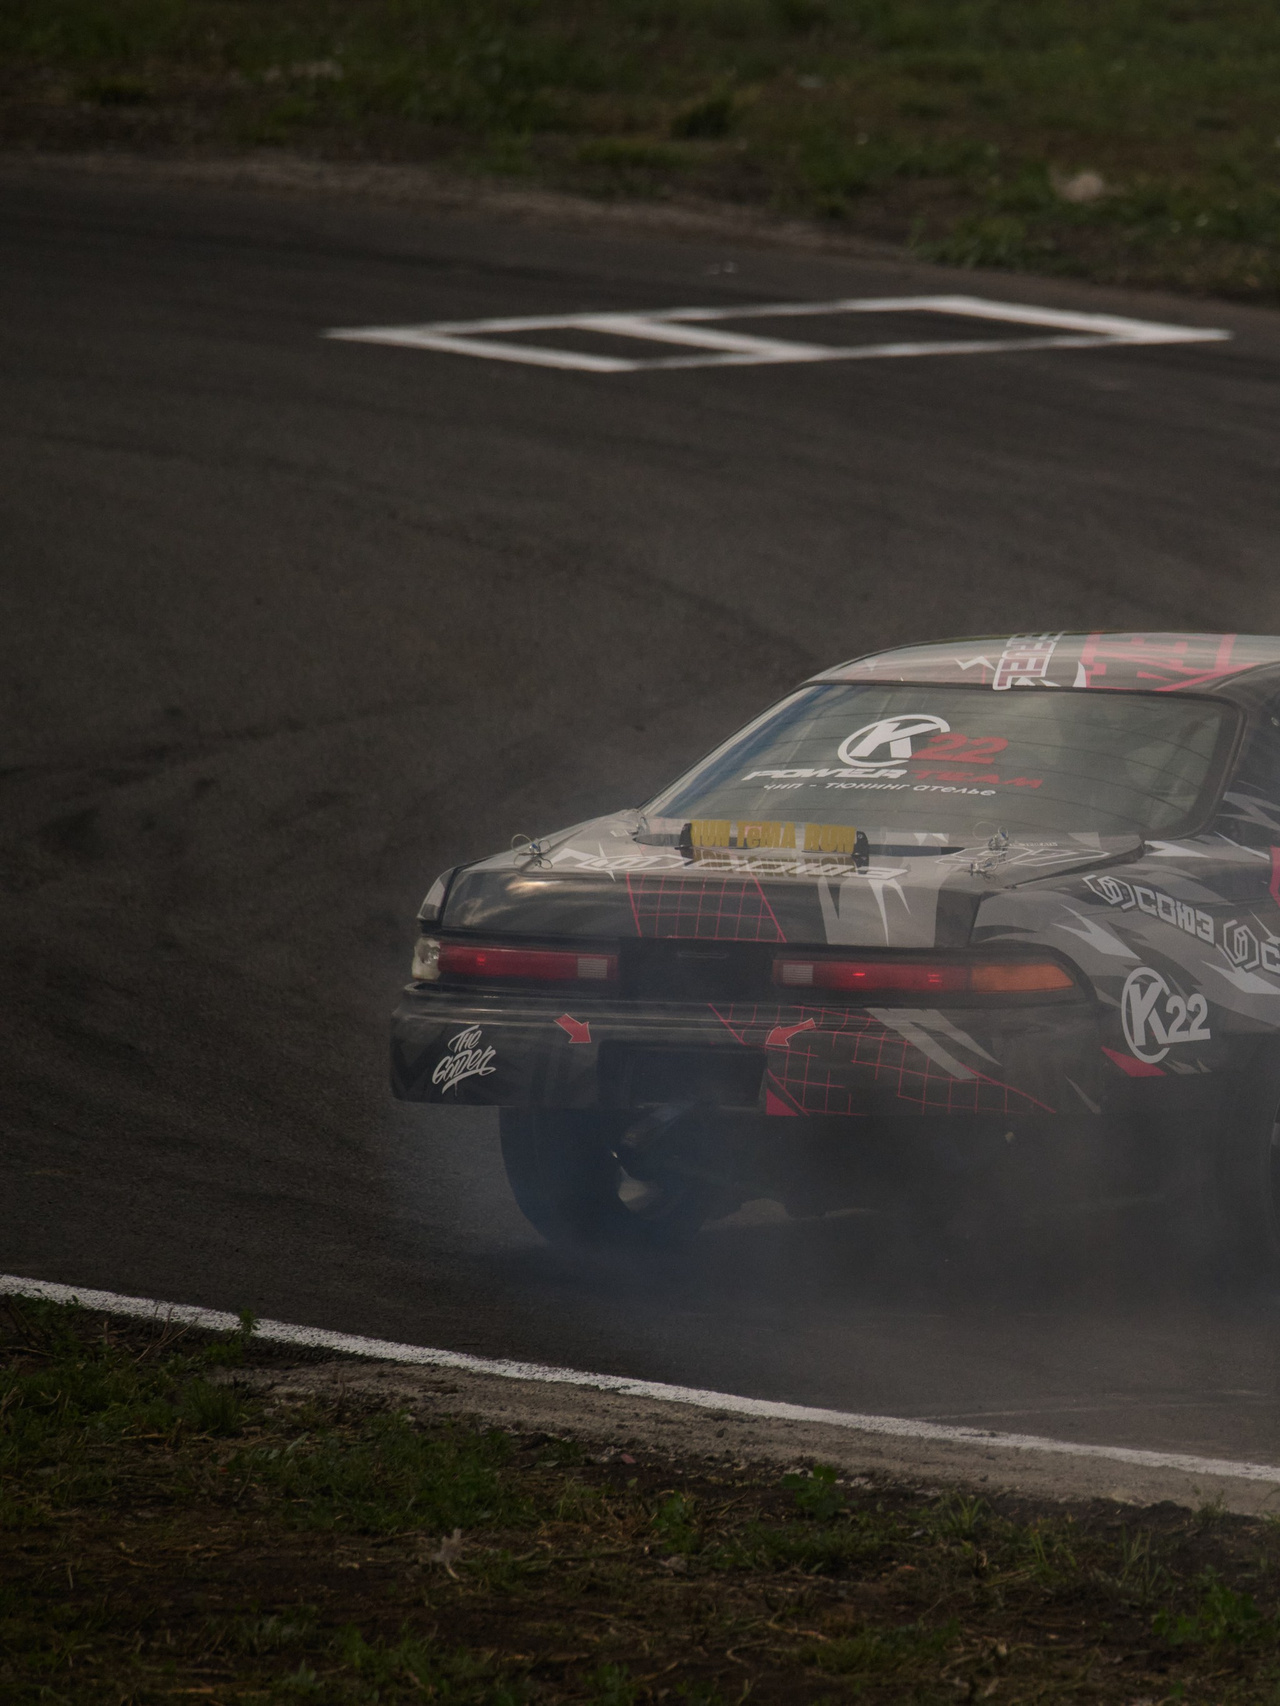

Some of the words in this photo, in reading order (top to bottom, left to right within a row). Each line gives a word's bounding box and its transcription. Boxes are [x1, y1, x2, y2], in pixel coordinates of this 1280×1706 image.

[741, 768, 908, 782] POWER
[912, 769, 1044, 789] TEAM
[804, 822, 857, 852] RUN
